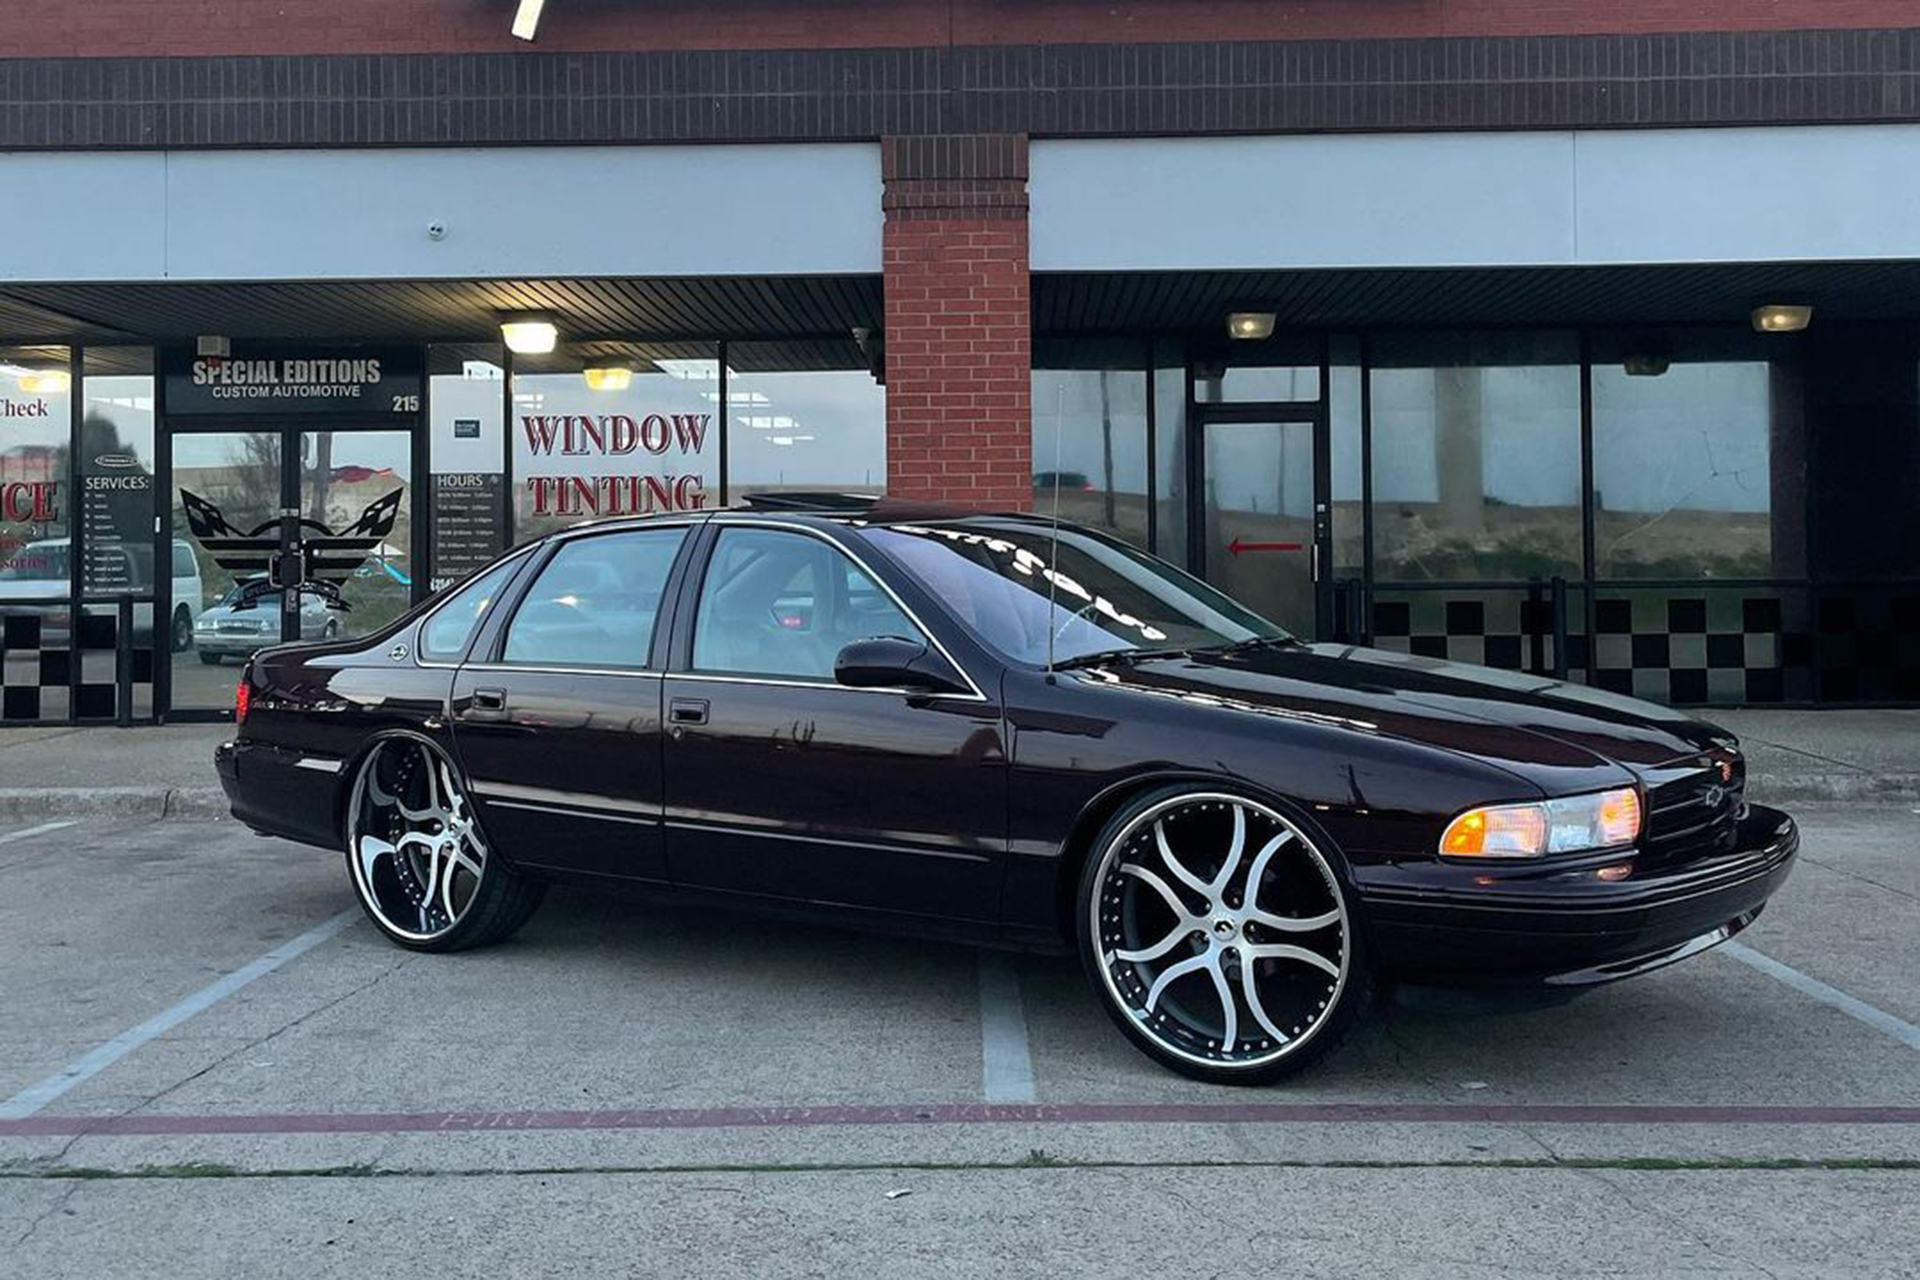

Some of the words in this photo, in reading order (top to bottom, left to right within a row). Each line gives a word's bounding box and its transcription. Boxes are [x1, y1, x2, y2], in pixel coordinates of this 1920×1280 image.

[193, 360, 278, 385] SPECIAL
[283, 359, 381, 383] EDITIONS
[212, 386, 269, 398] CUSTOM
[272, 385, 360, 397] AUTOMOTIVE
[392, 396, 419, 411] 215
[521, 414, 711, 456] WINDOW
[85, 476, 149, 490] SERVICES:
[437, 475, 483, 487] HOURS
[527, 474, 706, 516] TINTING
